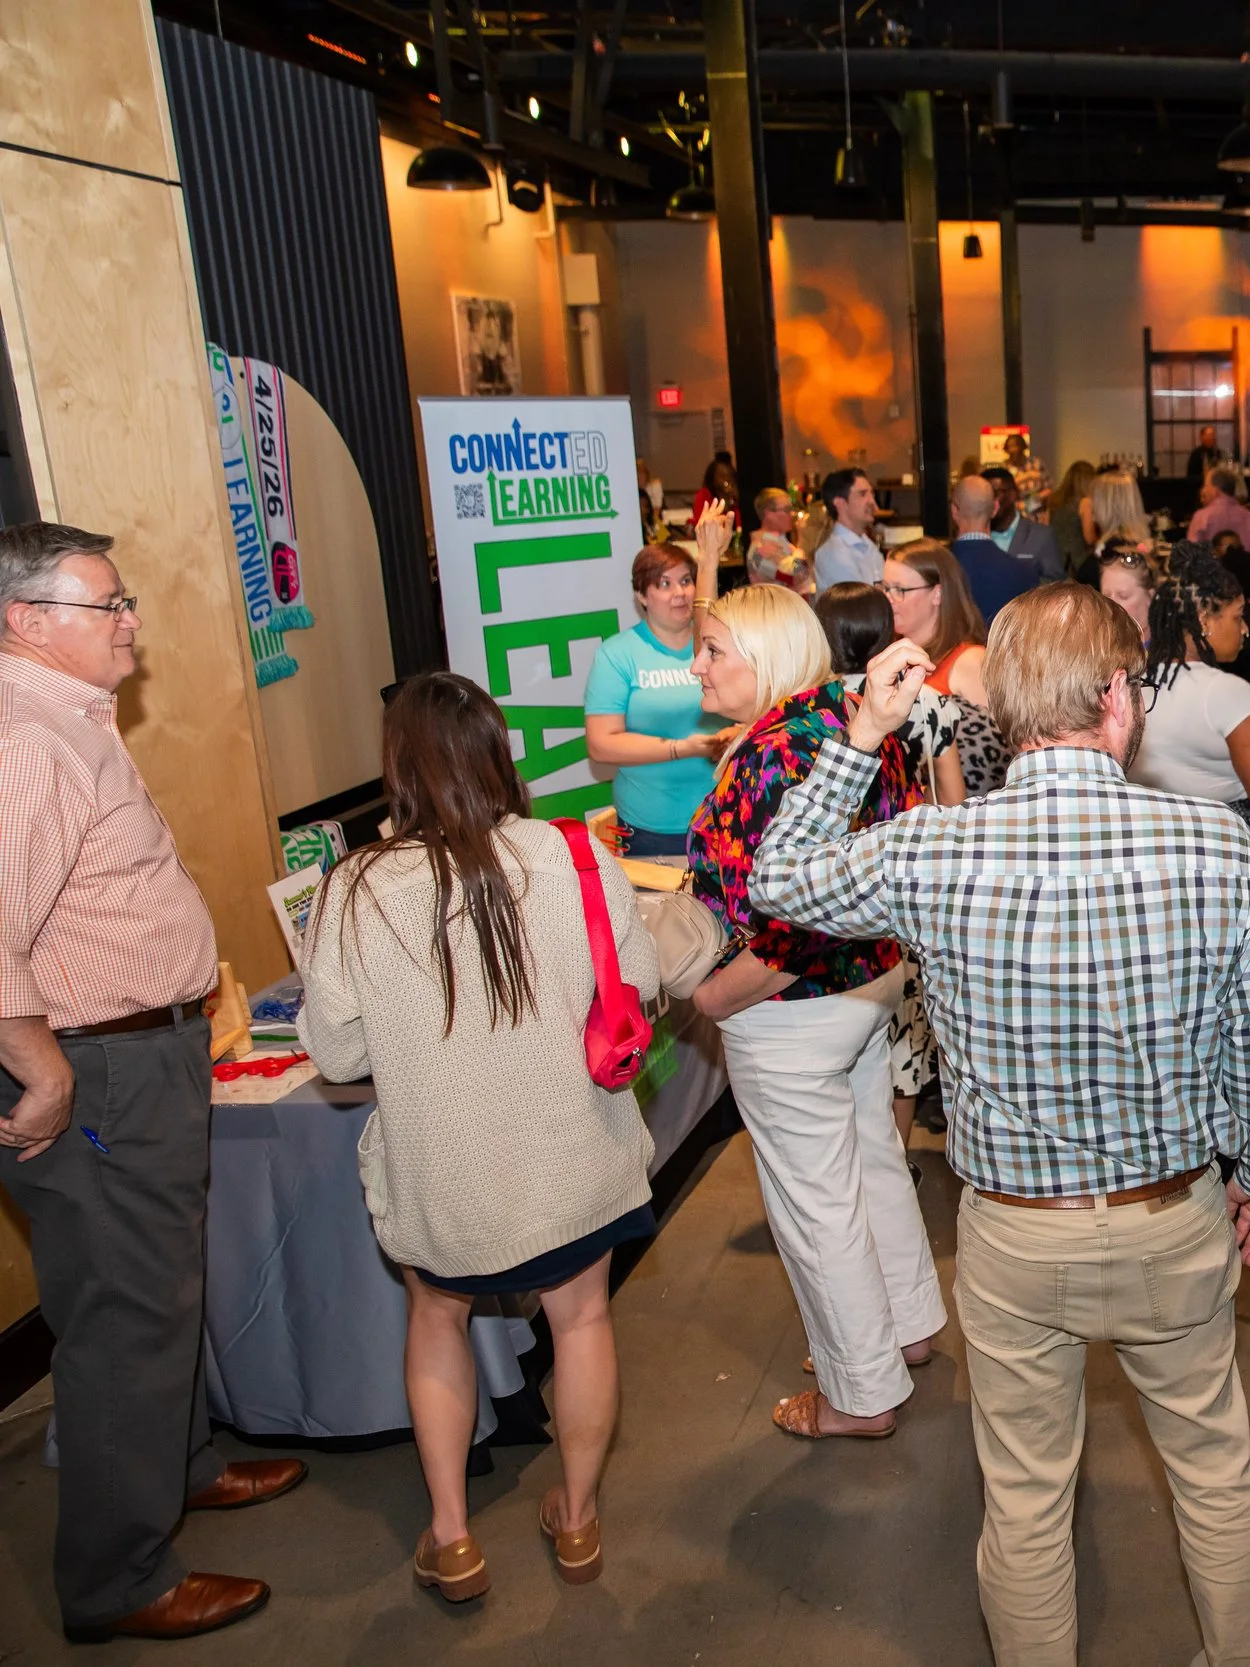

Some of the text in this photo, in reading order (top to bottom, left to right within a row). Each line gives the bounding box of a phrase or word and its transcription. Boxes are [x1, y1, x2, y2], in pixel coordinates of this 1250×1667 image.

[255, 375, 283, 518] 4/25/26
[449, 417, 608, 476] CONNECTED
[487, 470, 613, 526] LEARNING
